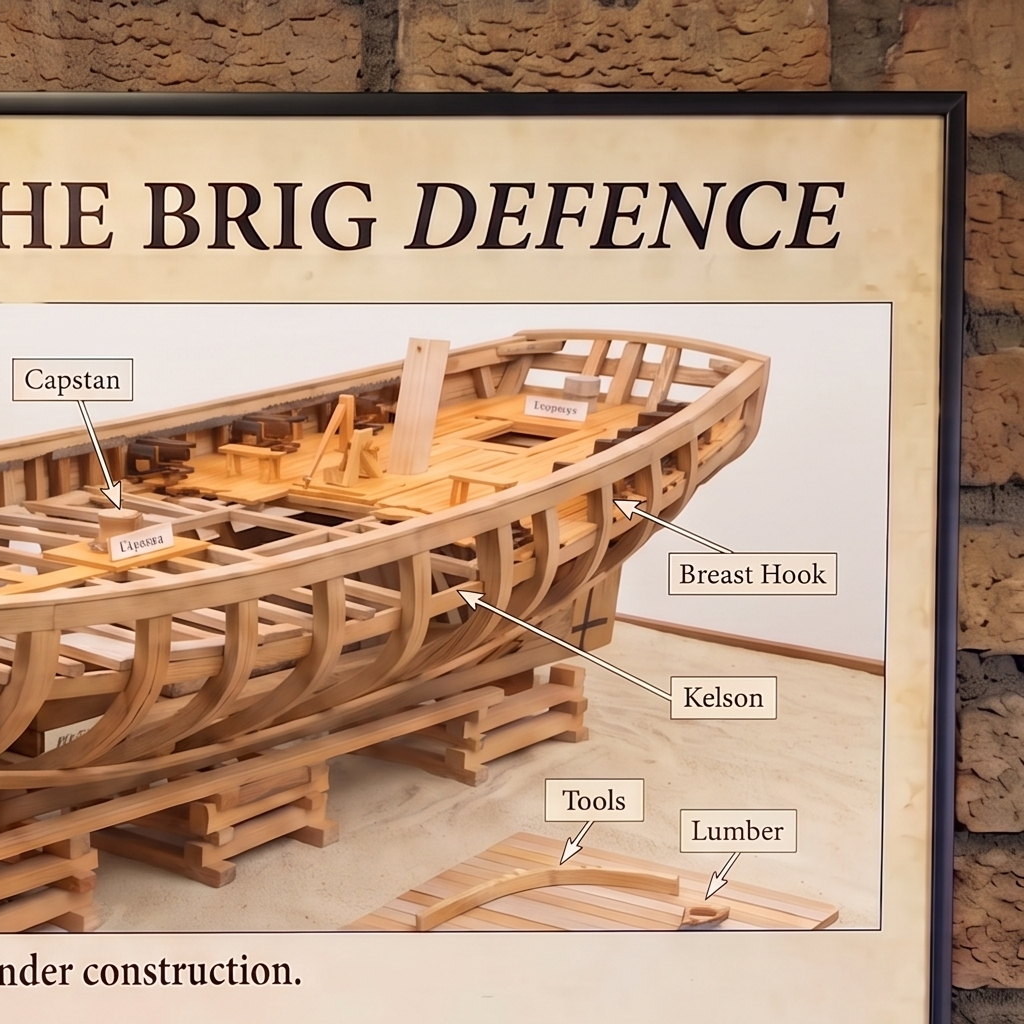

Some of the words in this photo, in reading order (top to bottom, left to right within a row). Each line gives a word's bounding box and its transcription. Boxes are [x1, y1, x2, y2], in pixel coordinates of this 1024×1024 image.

[142, 181, 377, 252] BRIG
[403, 180, 846, 251] DEFENCE
[24, 368, 121, 396] Capstan
[679, 563, 754, 585] Breast
[760, 562, 827, 585] Hook
[683, 685, 764, 708] Kelson
[561, 788, 626, 811] Tools
[691, 819, 785, 841] Lumber
[82, 953, 302, 986] construction.
